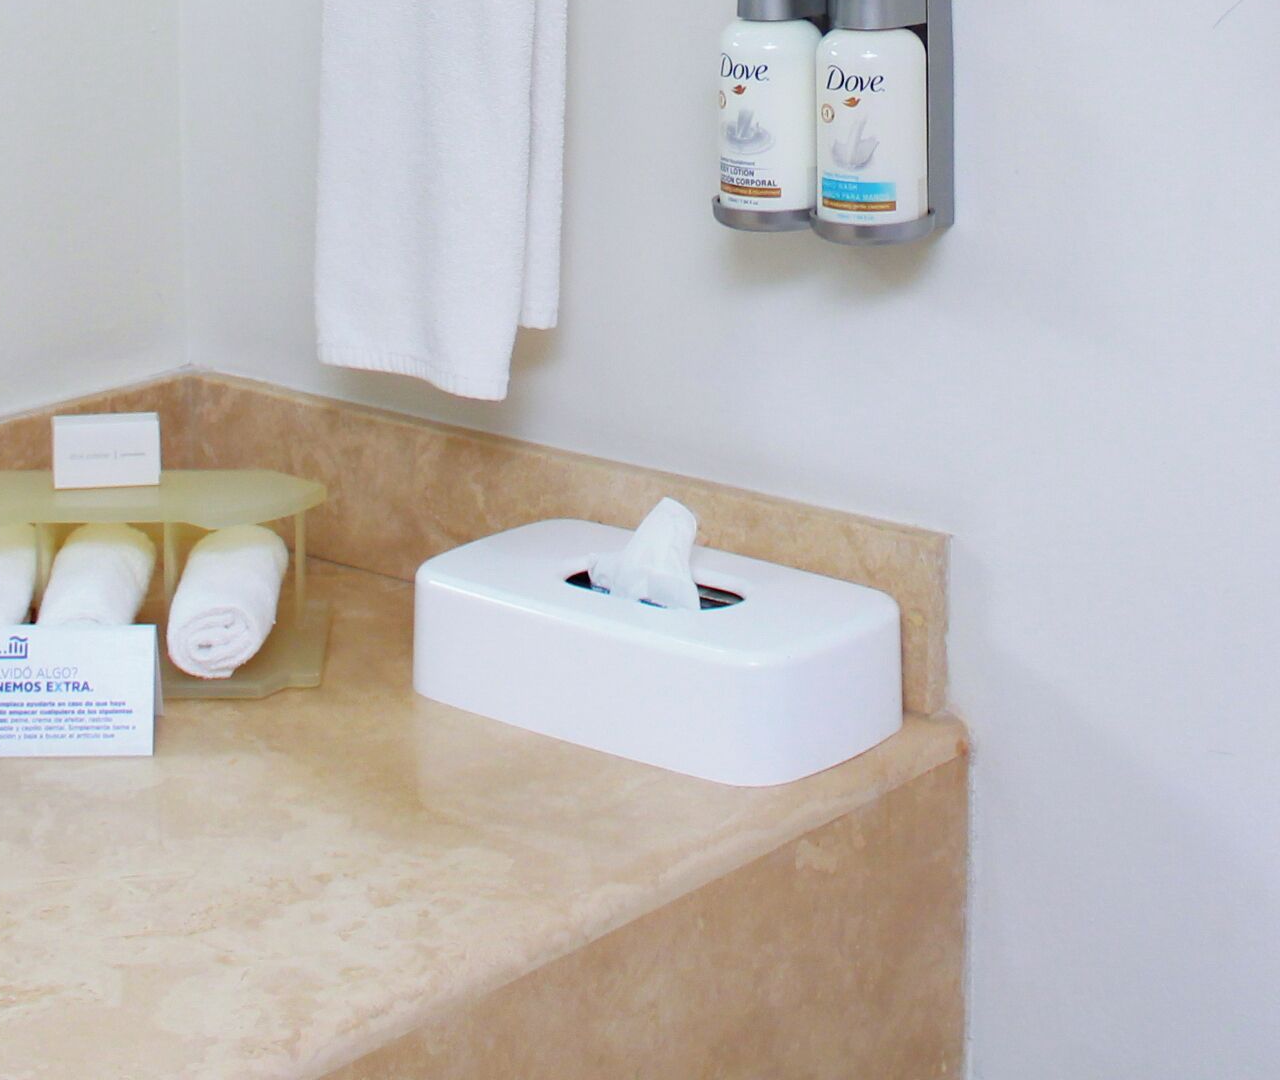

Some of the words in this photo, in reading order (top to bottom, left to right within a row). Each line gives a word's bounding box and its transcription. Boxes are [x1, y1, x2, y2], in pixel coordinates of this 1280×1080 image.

[720, 53, 768, 81] Dove
[826, 65, 883, 92] Dove
[730, 167, 755, 176] LOTION
[736, 177, 776, 186] CORPORAL
[36, 666, 78, 679] ALGO?
[46, 681, 94, 692] EXTRA.
